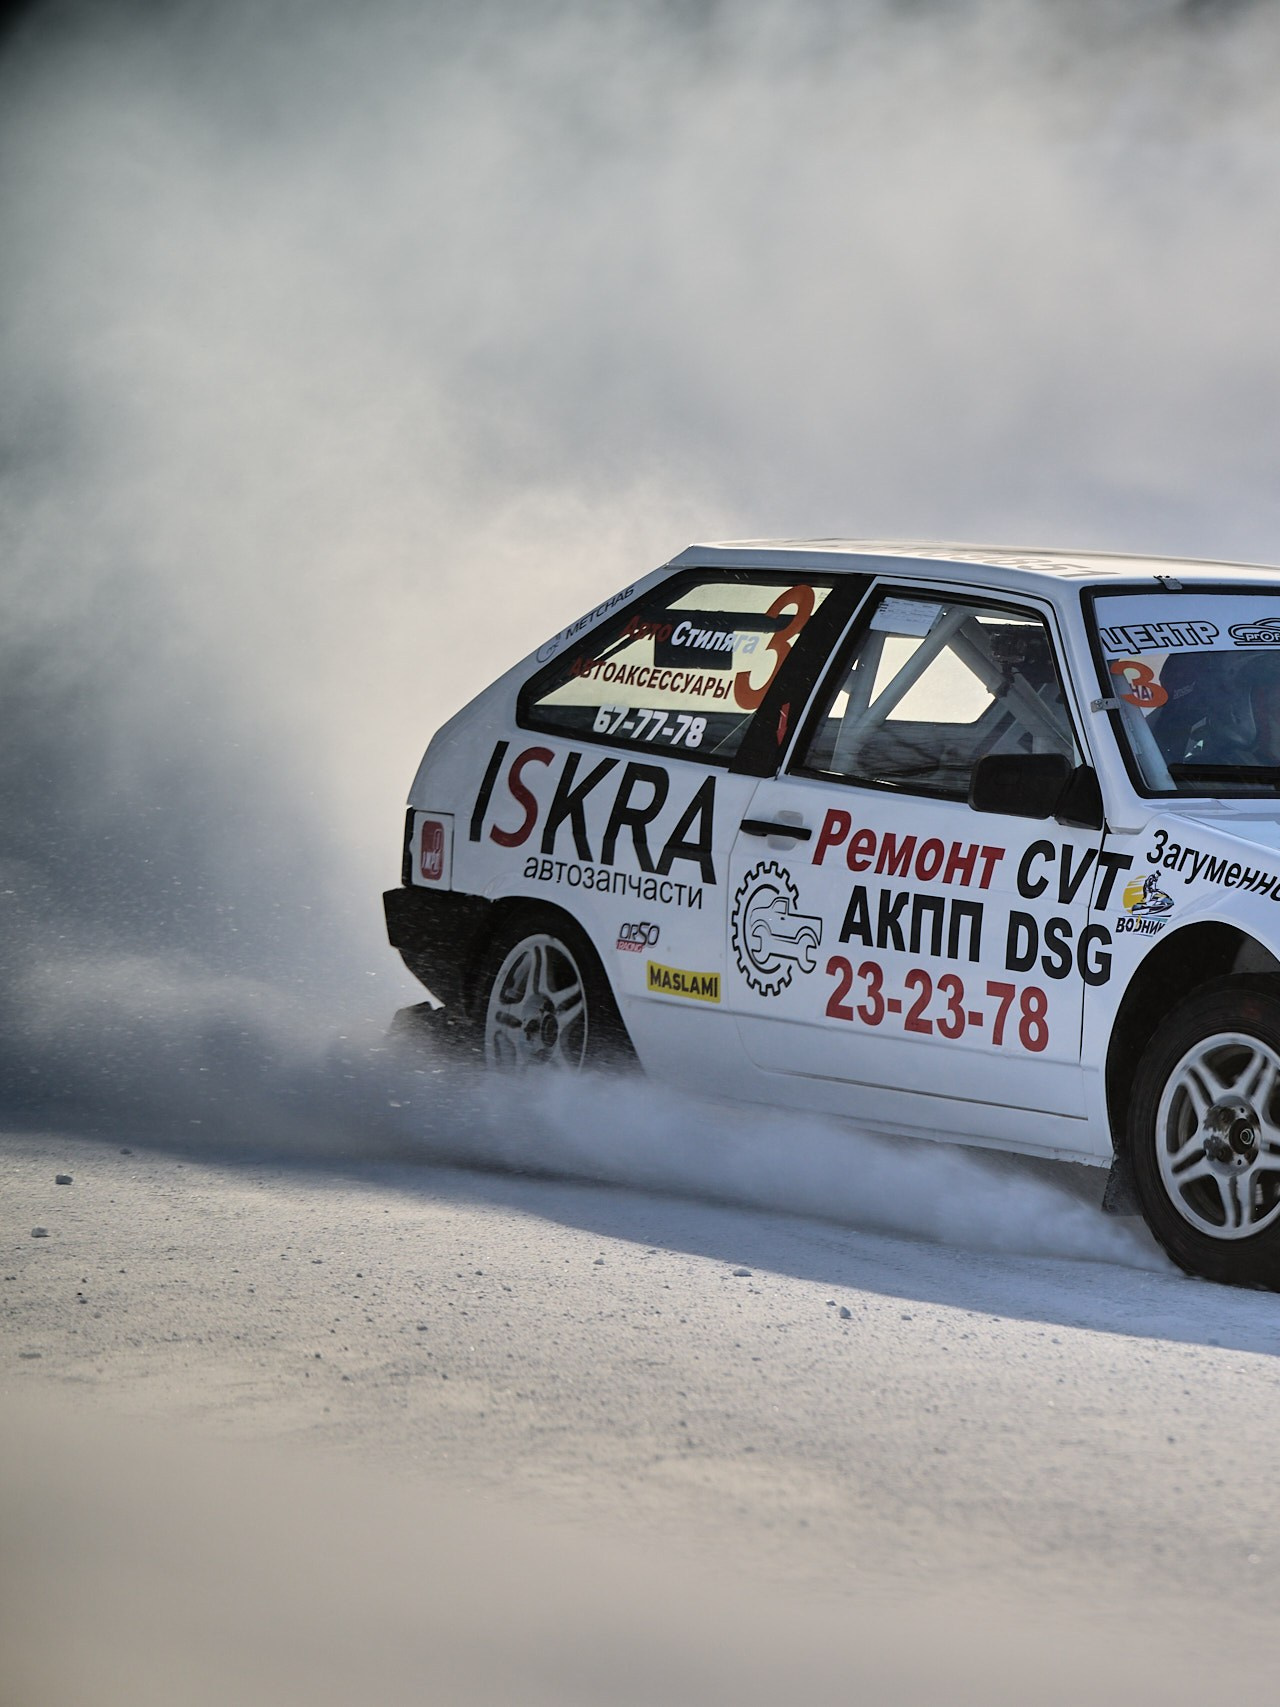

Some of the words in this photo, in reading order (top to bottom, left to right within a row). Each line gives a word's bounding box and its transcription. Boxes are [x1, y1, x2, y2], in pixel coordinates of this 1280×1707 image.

[565, 585, 635, 640] МЕТСНАБ
[1100, 621, 1220, 654] ЦЕНТР
[733, 584, 815, 710] 3
[568, 656, 734, 700] АВТОАКСЕССУАРЫ
[1110, 660, 1168, 707] 3
[593, 705, 707, 748] 67-77-78
[469, 740, 717, 885] ISKRA
[523, 856, 703, 909] автозапчасти
[811, 808, 1006, 889] Ремонт
[1016, 840, 1134, 911] CVT
[838, 885, 984, 963] АКПП
[1005, 910, 1113, 986] DSG
[650, 966, 718, 998] MASLAMI
[825, 955, 1049, 1052] 23-23-78
